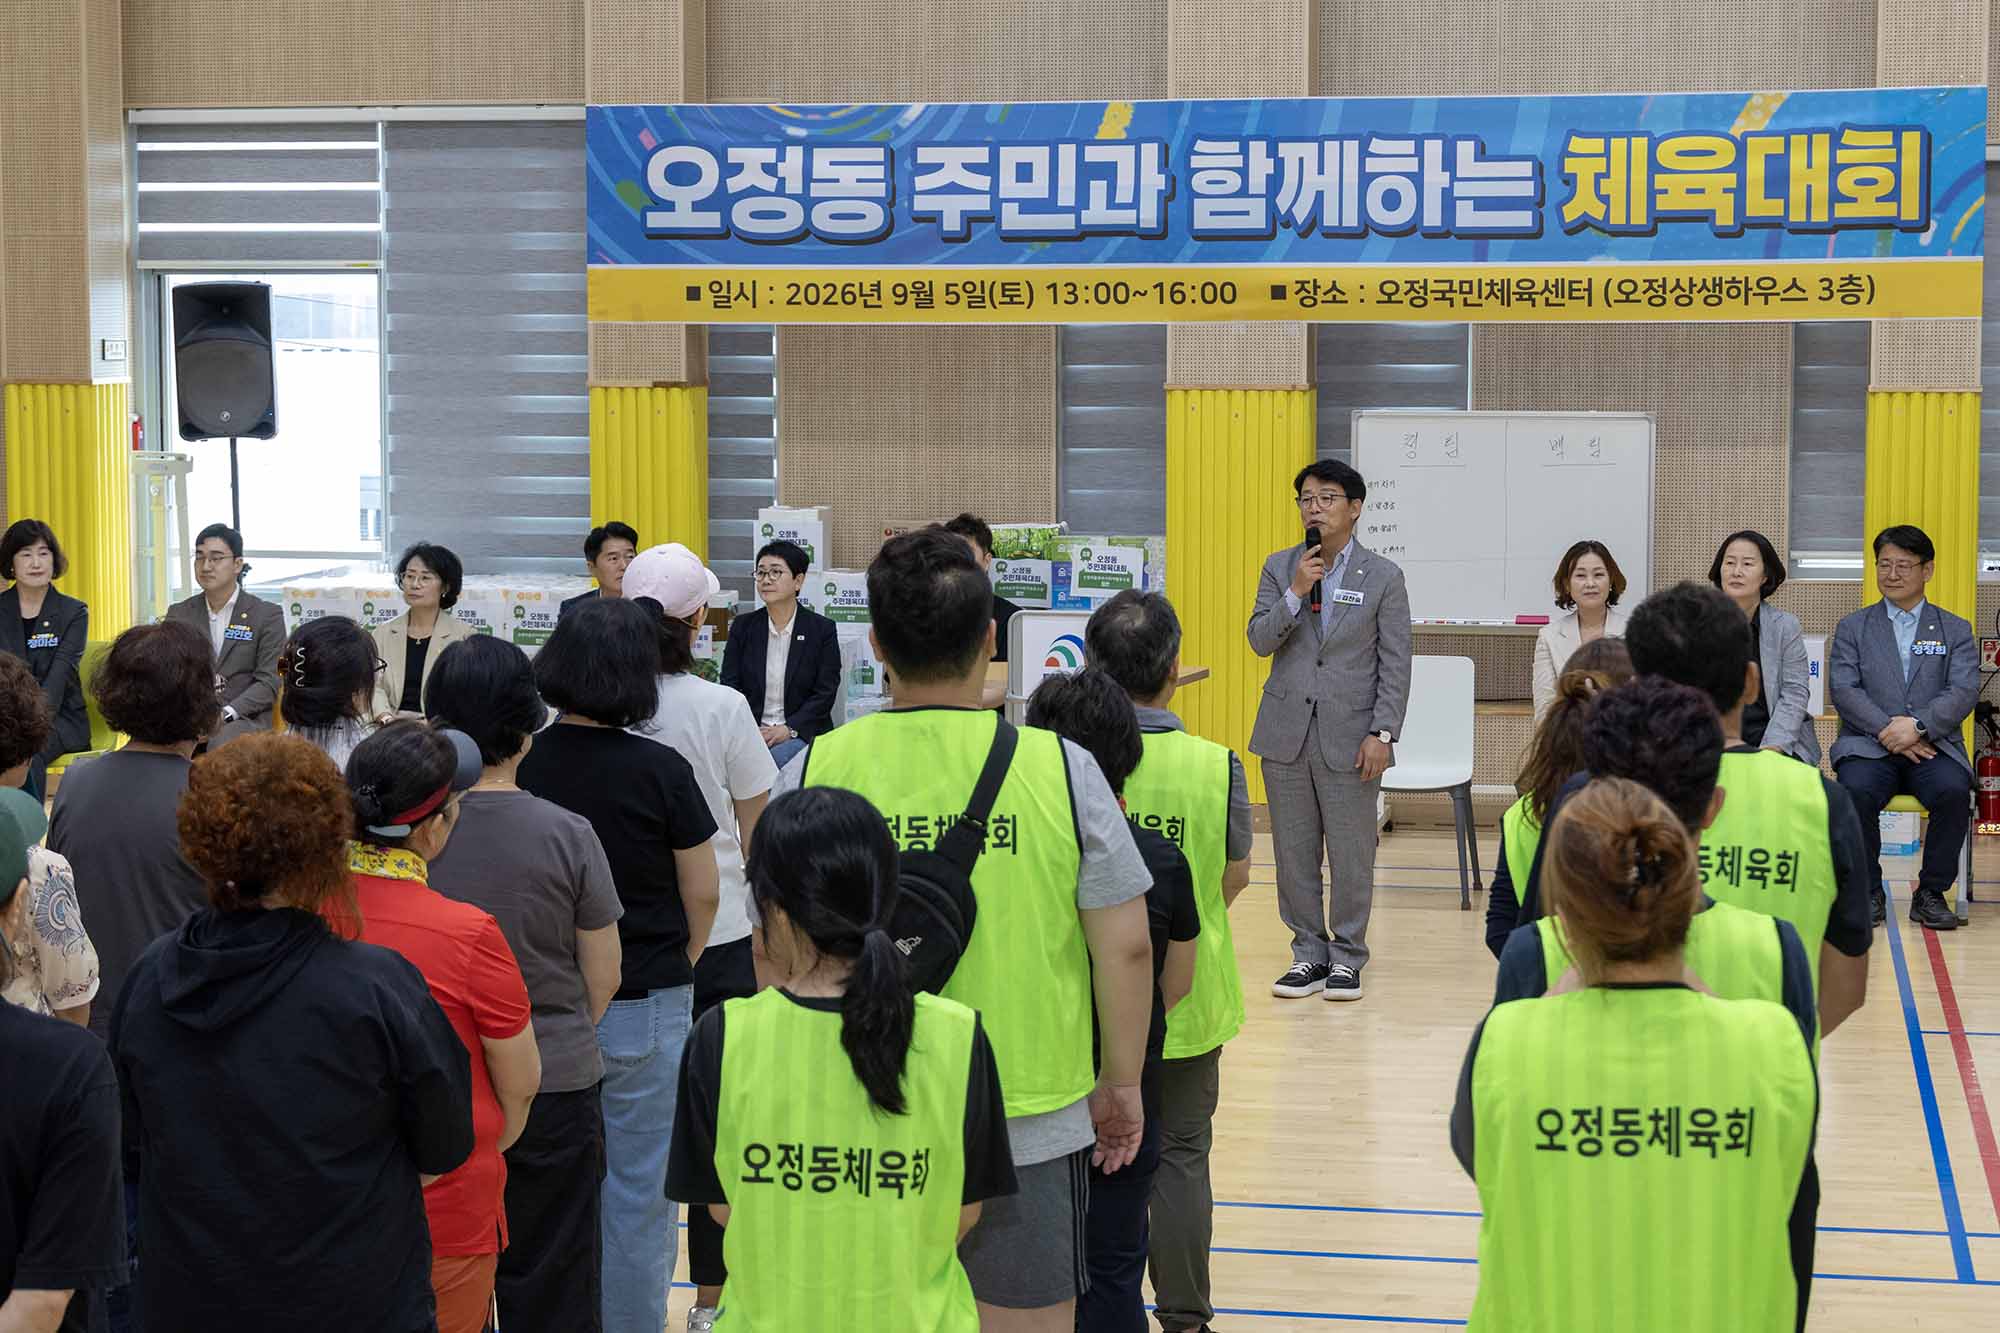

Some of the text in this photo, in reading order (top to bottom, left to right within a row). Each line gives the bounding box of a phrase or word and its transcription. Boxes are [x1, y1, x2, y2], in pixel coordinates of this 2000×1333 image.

[645, 130, 1923, 235] 오정동 주민과 함께하는 체육대회
[708, 280, 757, 308] 일시
[785, 280, 883, 308] 2026년
[891, 280, 935, 309] 9월
[944, 279, 1035, 309] 5일(토)
[1045, 281, 1238, 305] 13:00~16:00
[1294, 278, 1349, 308] 장소
[1375, 277, 1594, 309] 오정국민체육센터
[1603, 276, 1809, 308] (오정상생하우스
[1818, 274, 1876, 305] 3층)
[1096, 555, 1117, 564] 오정동
[1535, 1106, 1755, 1159] 오정동체육회
[741, 1142, 930, 1200] 오정동체육회
